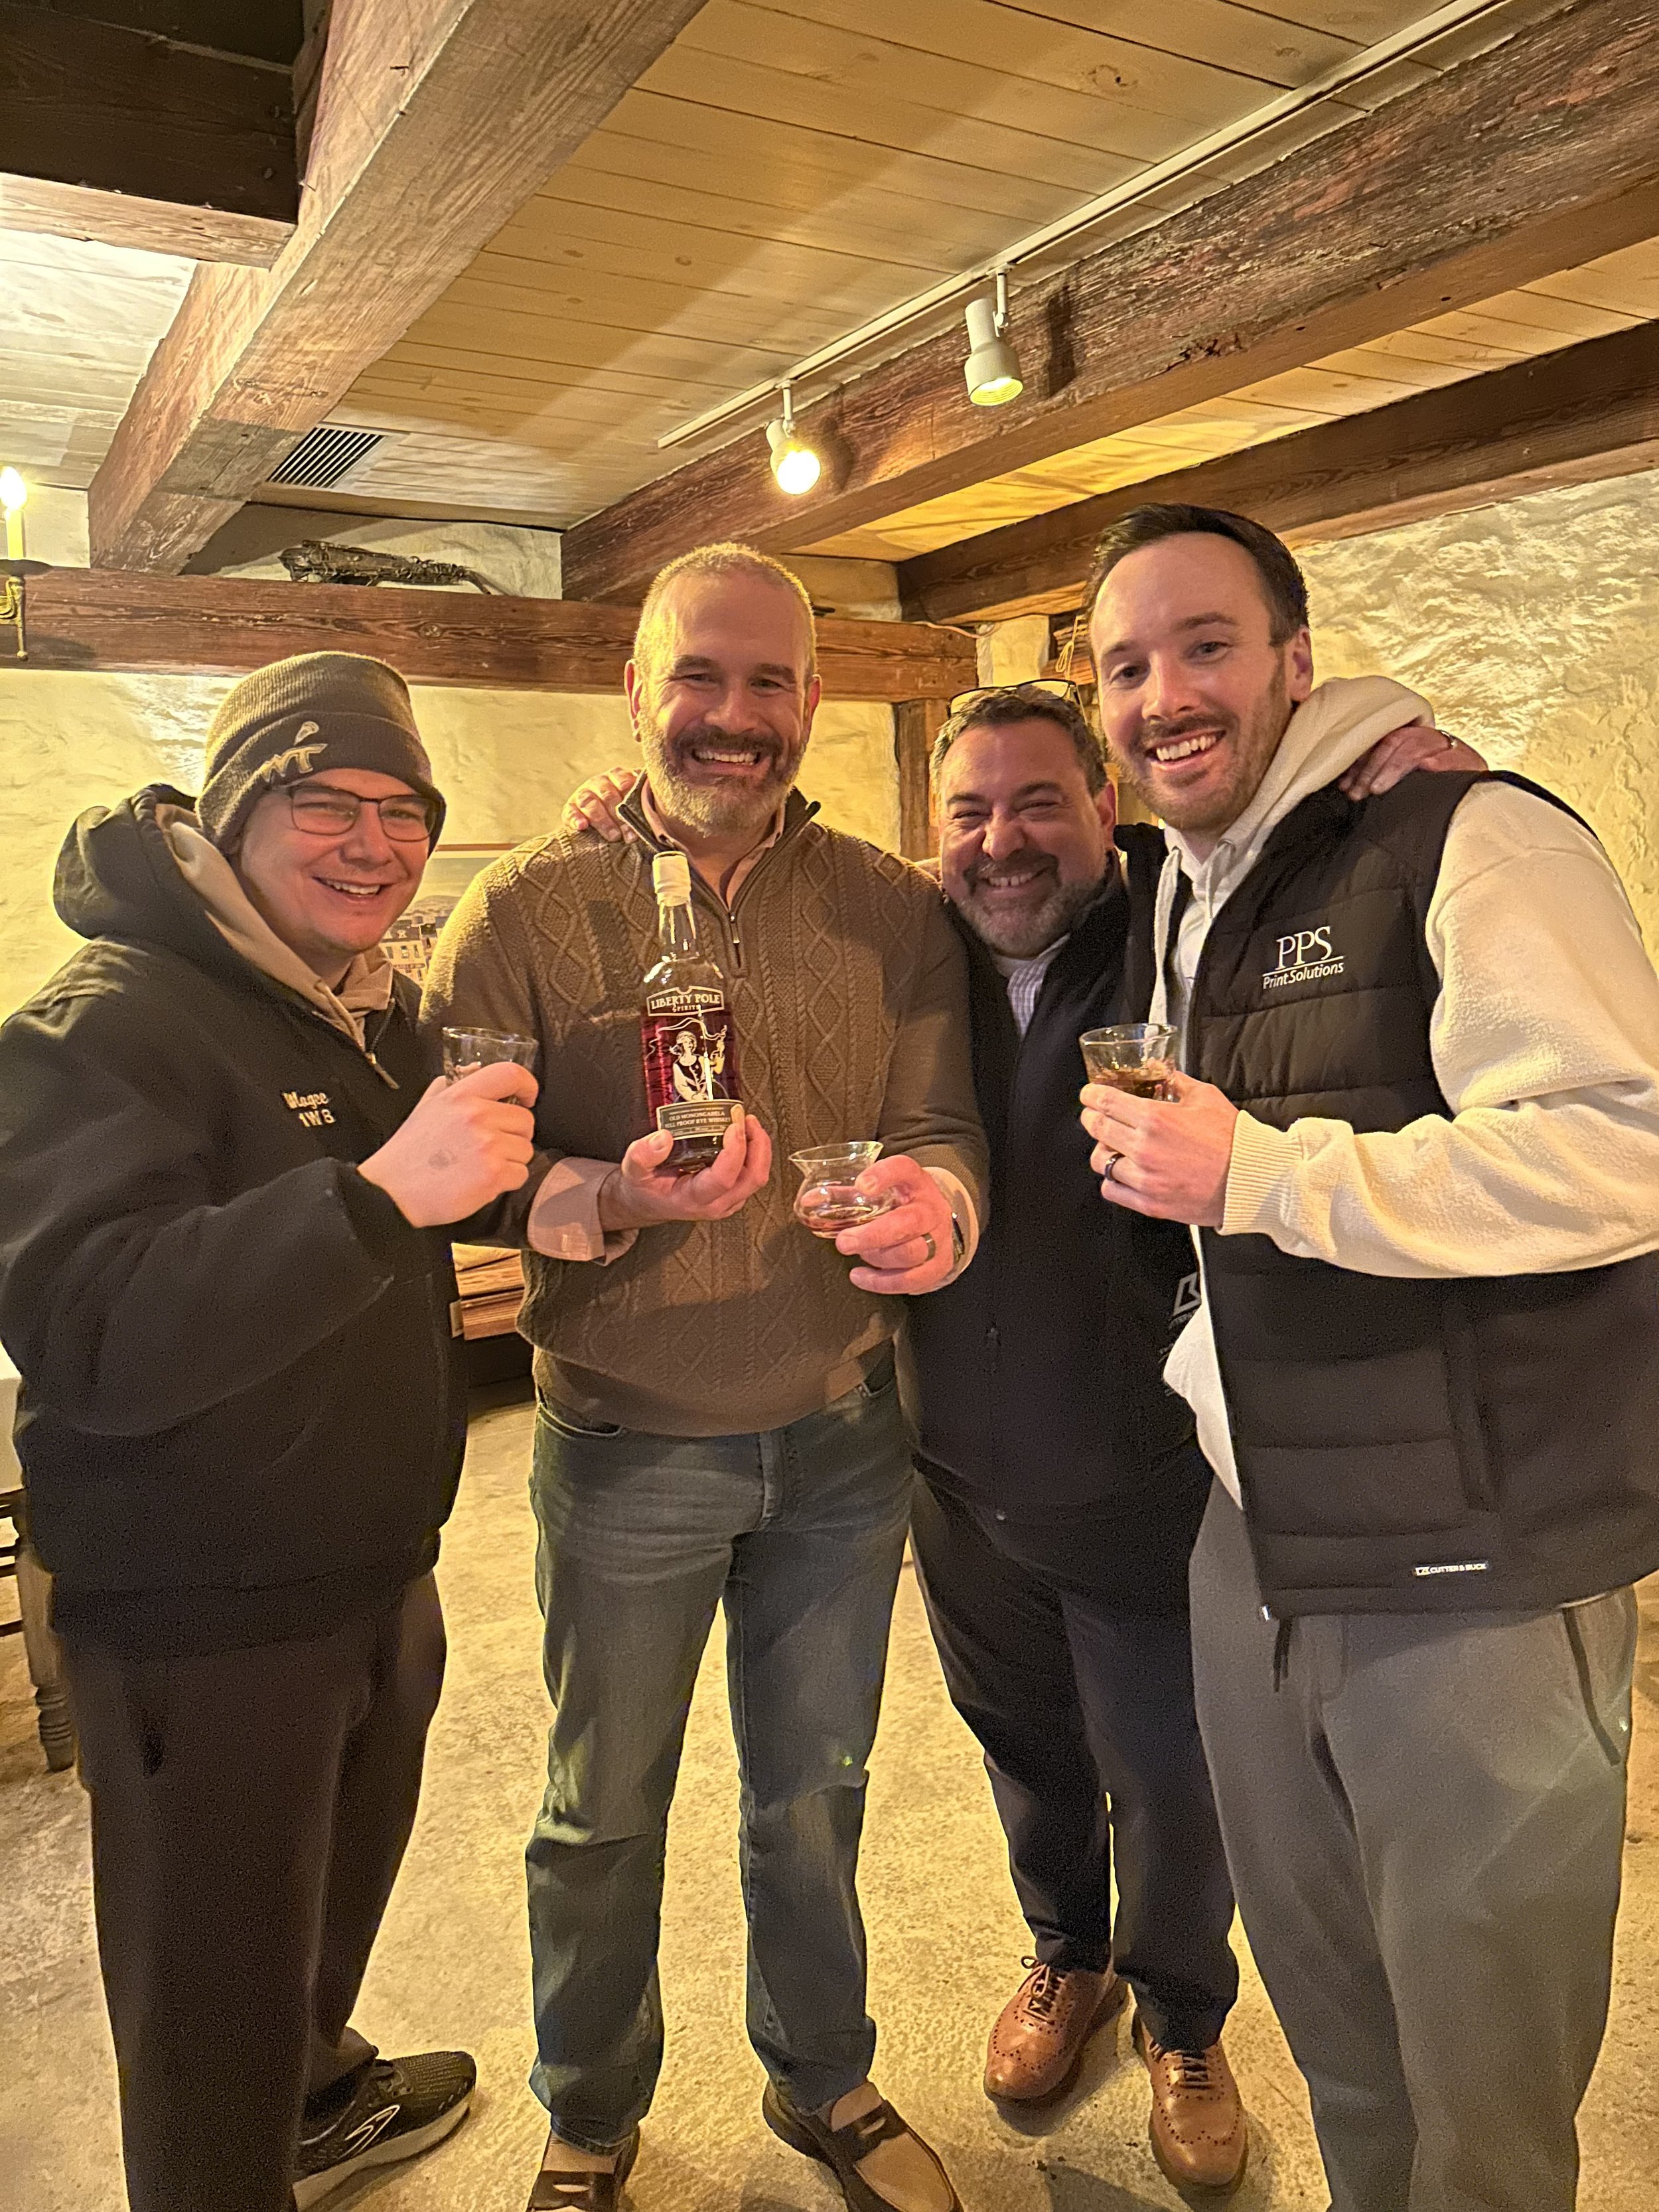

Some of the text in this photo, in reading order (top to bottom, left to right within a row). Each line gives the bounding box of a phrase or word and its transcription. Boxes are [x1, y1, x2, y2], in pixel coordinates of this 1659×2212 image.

[1274, 926, 1333, 970] PPS
[650, 994, 721, 1009] LIBERTY POLE
